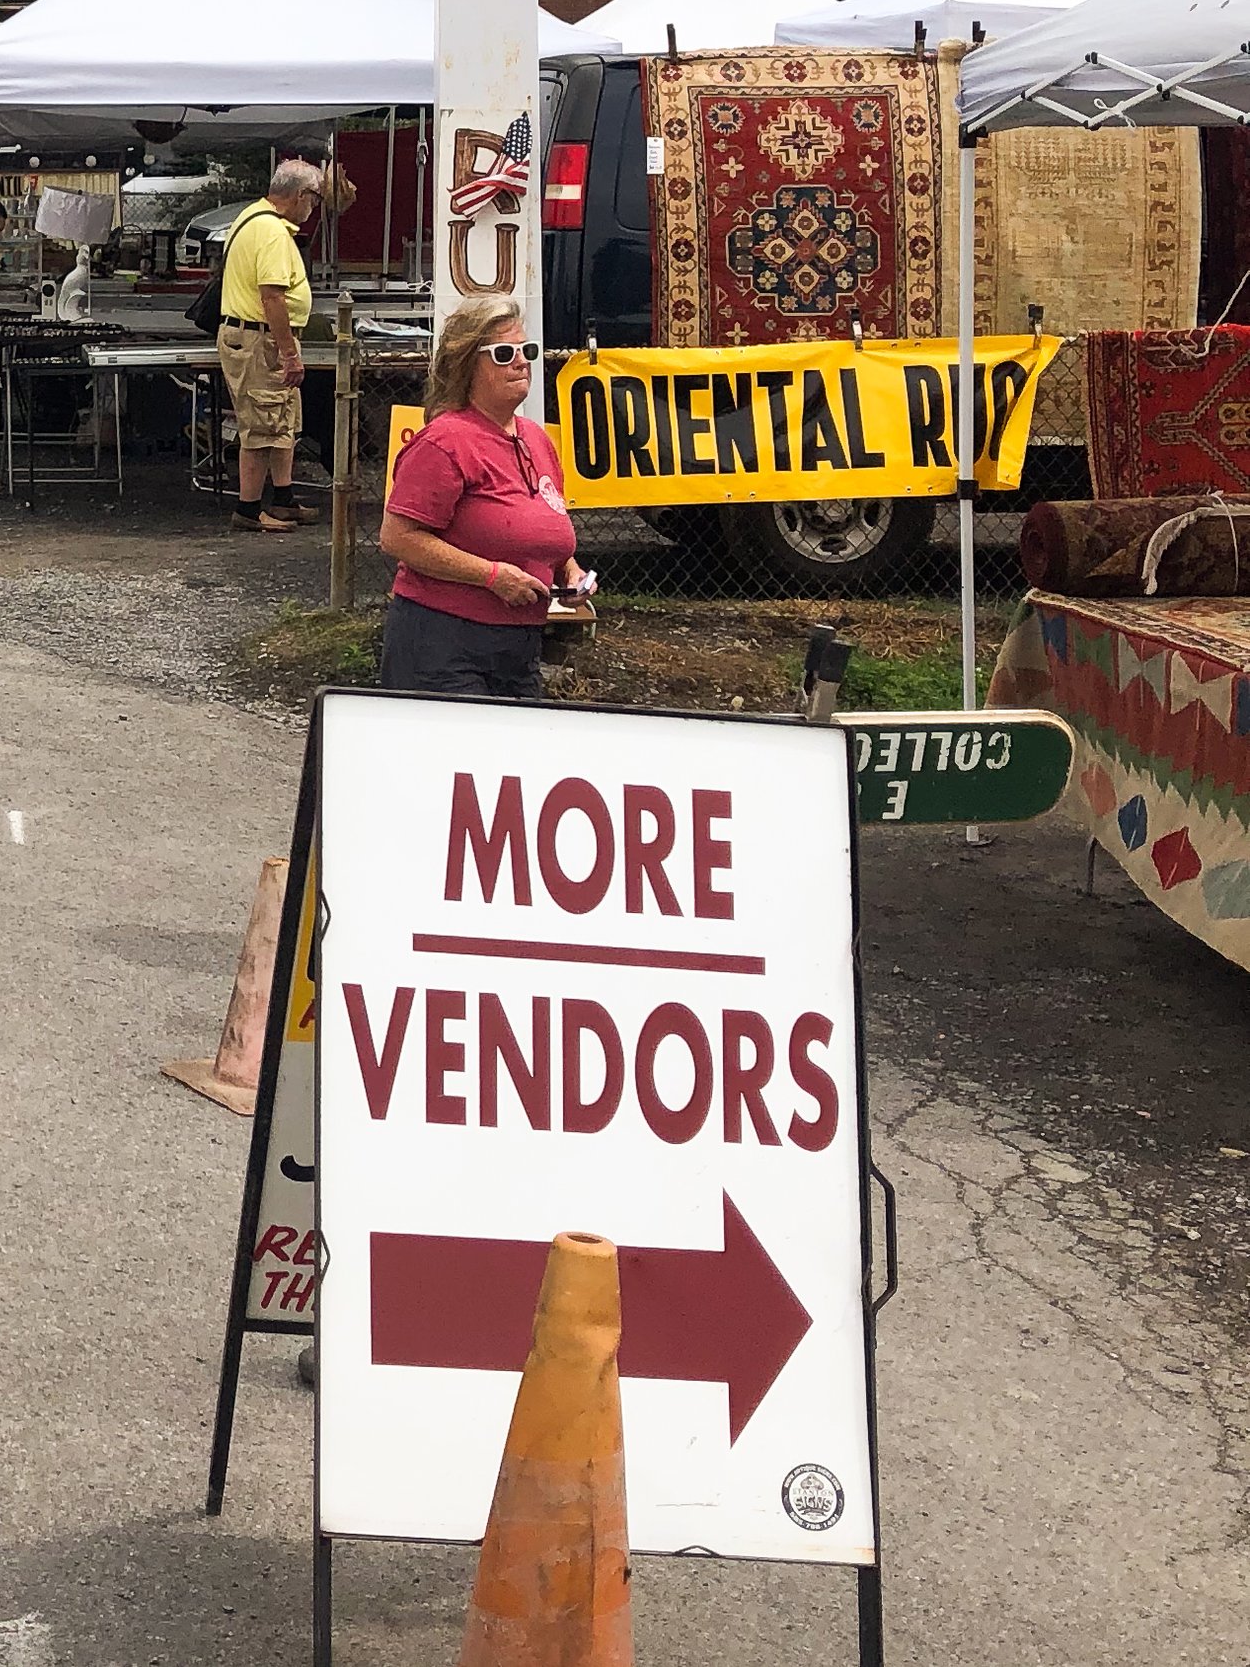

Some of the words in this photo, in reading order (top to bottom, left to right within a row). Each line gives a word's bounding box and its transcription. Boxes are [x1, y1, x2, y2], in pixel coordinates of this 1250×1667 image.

[570, 368, 885, 480] ORIENTAL
[444, 772, 734, 920] MORE
[341, 983, 840, 1152] VENDORS
[253, 1224, 315, 1265] RE
[260, 1271, 315, 1313] TH
[795, 1496, 832, 1511] SIGNS
